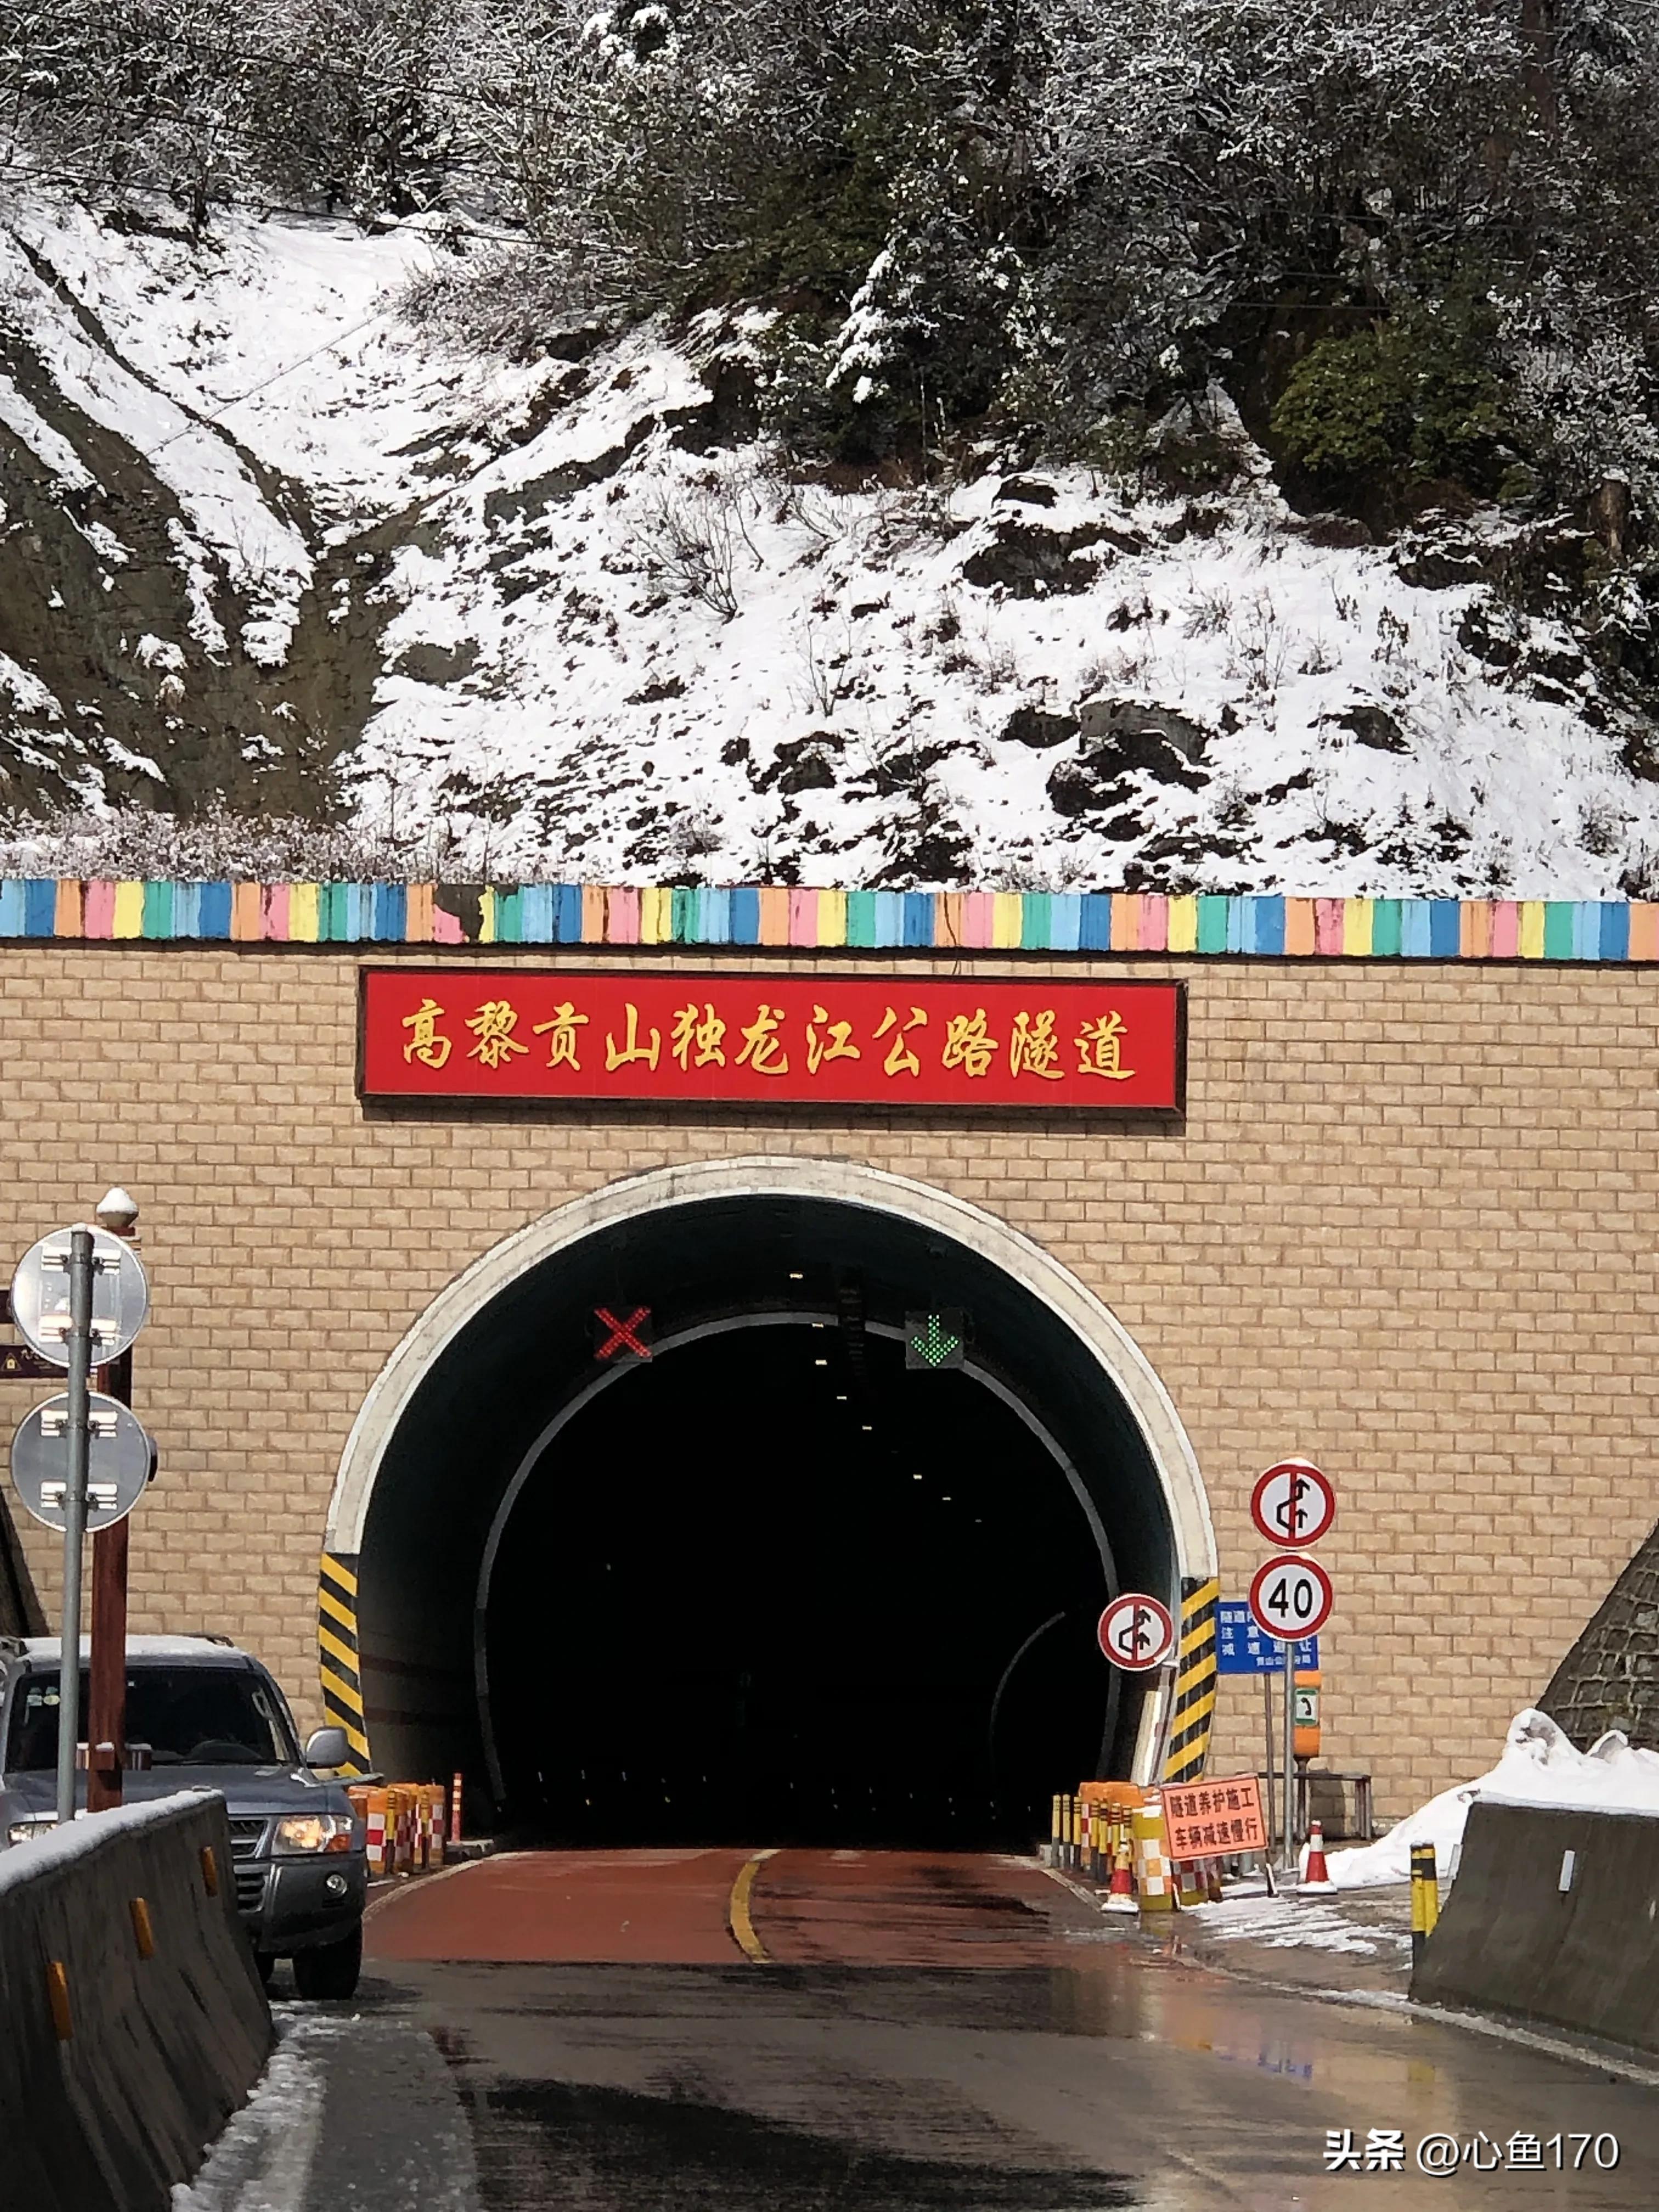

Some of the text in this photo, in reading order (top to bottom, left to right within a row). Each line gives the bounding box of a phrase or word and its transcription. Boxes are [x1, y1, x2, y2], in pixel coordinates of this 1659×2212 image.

[402, 998, 1136, 1080] 高黎贡山独龙江公路隧道
[1268, 1578, 1313, 1618] 40
[1170, 1787, 1255, 1818] 隧道养护施工
[1175, 1817, 1258, 1850] 车辆减速慢行
